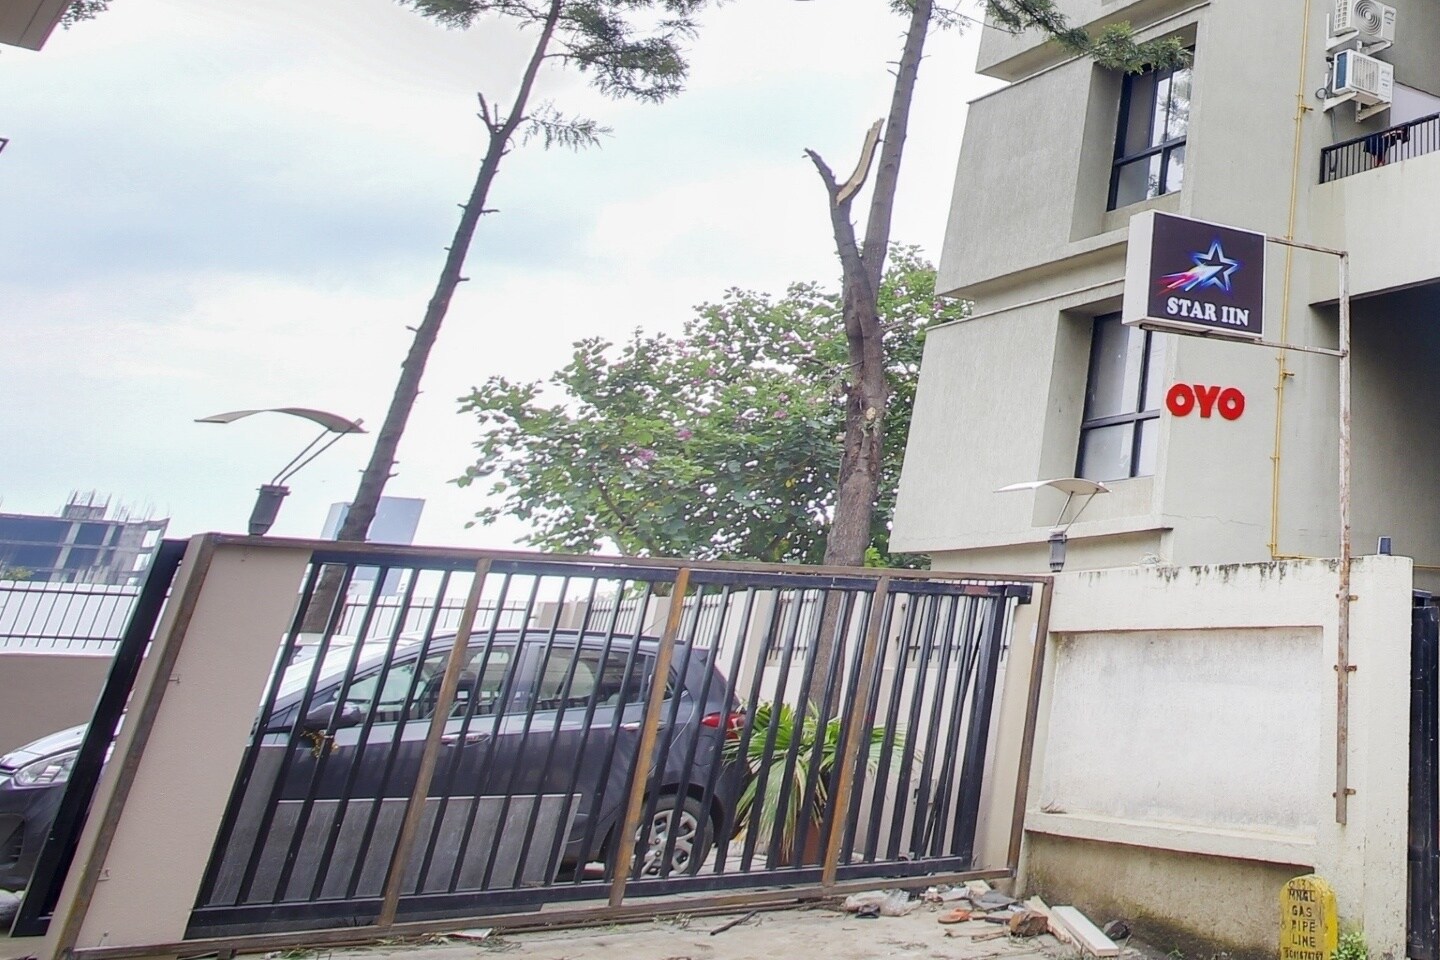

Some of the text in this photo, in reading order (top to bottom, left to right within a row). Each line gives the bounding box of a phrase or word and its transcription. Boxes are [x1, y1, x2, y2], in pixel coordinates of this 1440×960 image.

[1167, 297, 1250, 327] STAR IIN
[1166, 383, 1245, 421] OYO
[1292, 905, 1312, 918] GAS
[1291, 920, 1316, 933] PIPE
[1292, 934, 1316, 948] LINE
